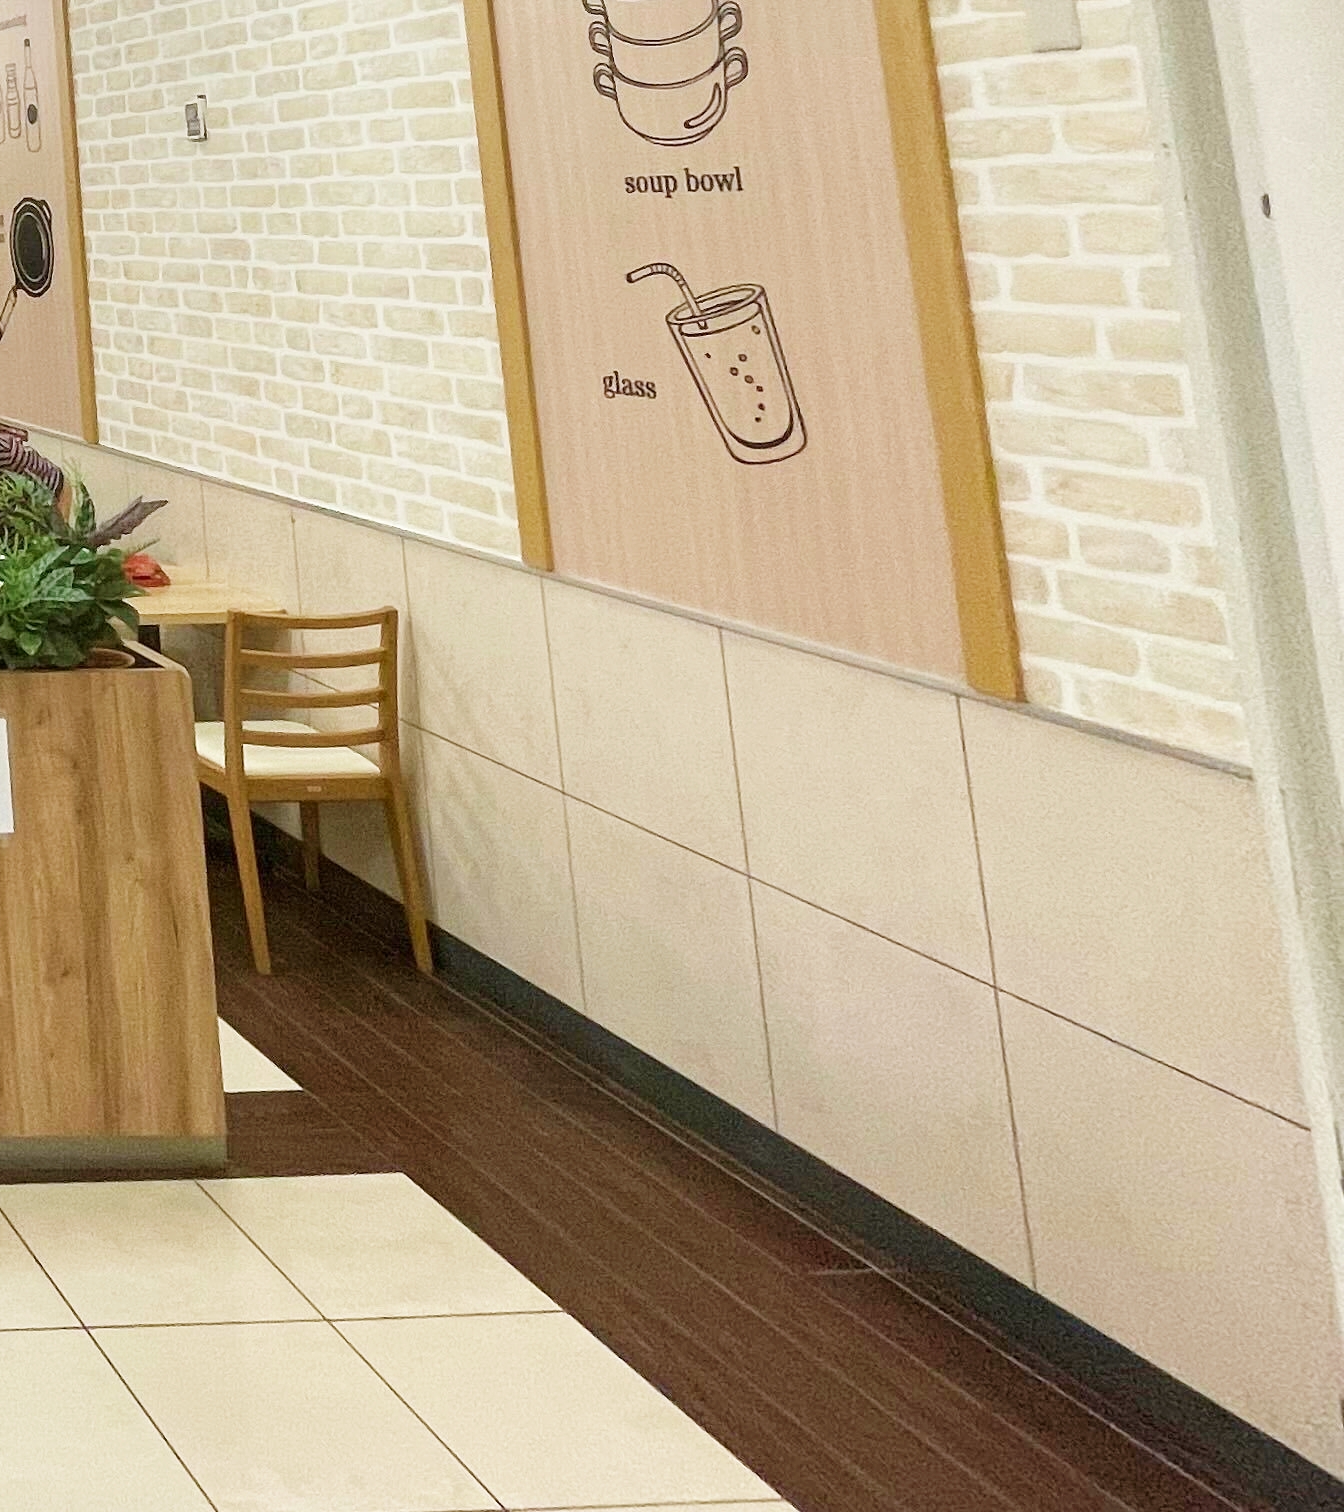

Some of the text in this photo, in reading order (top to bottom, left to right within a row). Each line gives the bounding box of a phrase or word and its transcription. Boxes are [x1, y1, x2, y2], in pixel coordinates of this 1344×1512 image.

[624, 166, 744, 199] soup bowl
[603, 371, 657, 400] glass
